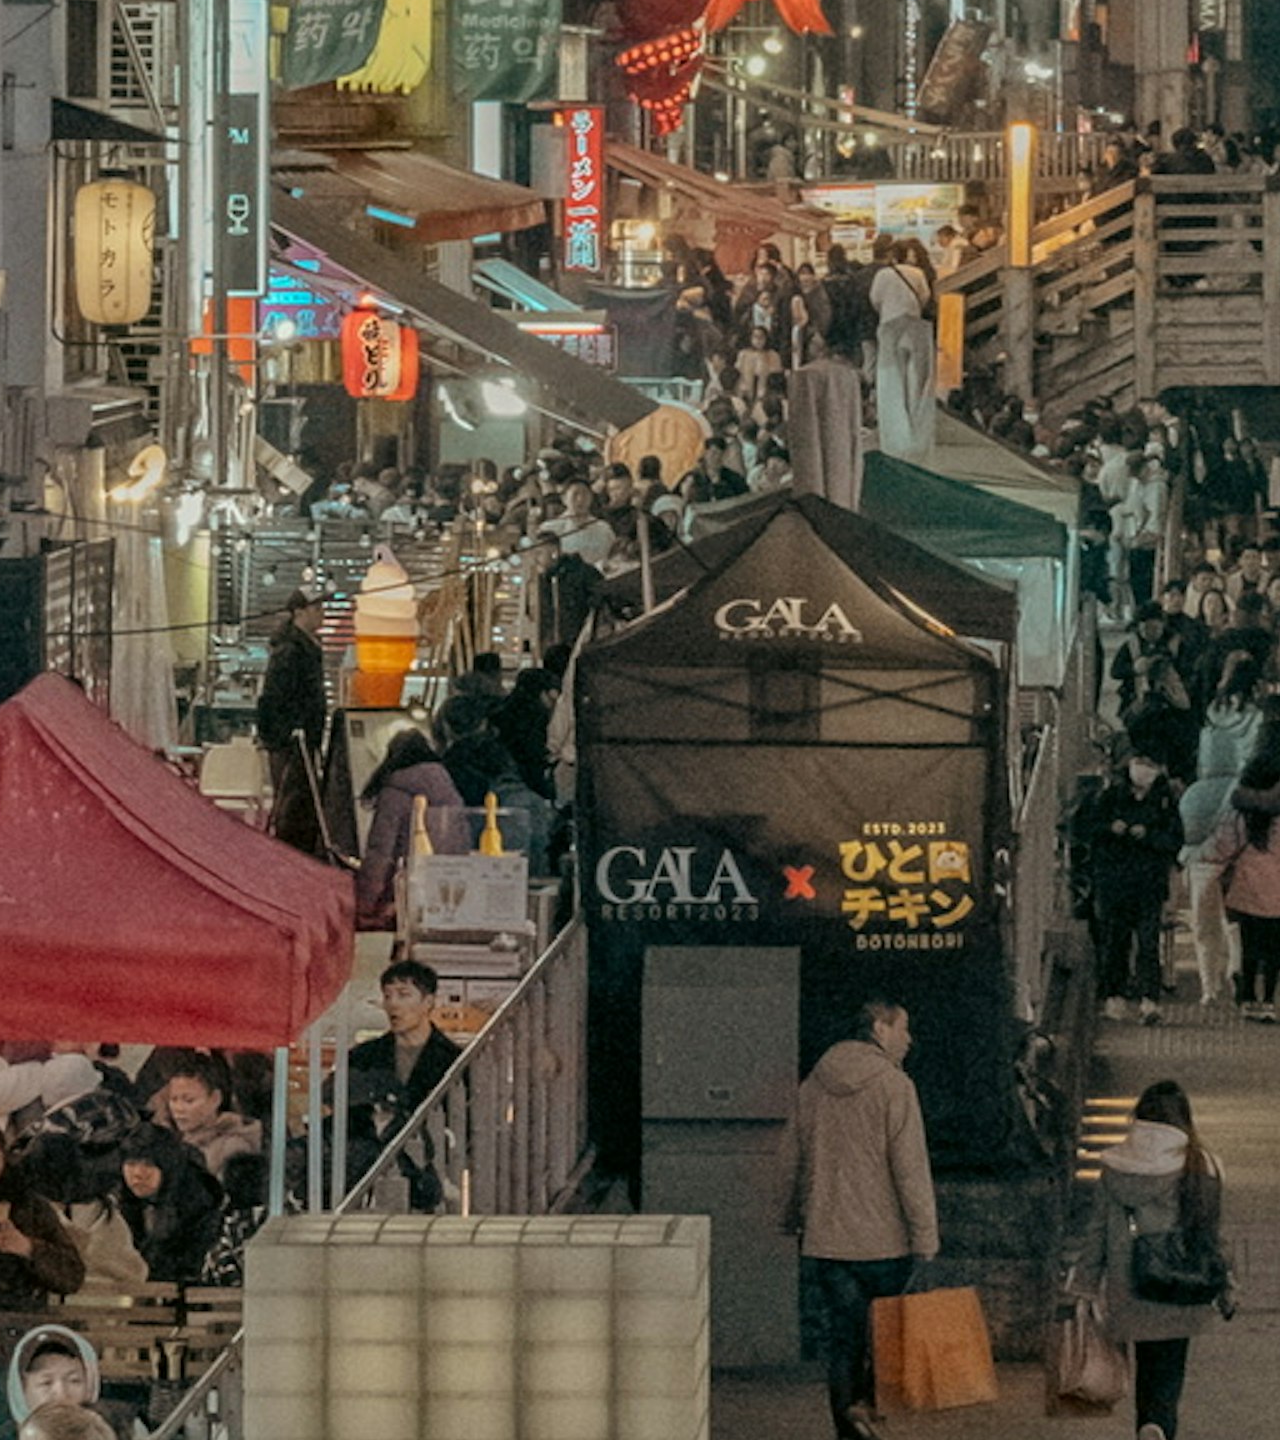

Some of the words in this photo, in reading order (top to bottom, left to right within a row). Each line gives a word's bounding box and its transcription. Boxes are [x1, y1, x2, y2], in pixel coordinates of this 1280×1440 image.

[463, 34, 501, 70] 药
[565, 109, 600, 271] ラーメン一蘭
[100, 192, 119, 298] モトカラ
[713, 596, 860, 635] GALA
[595, 846, 759, 905] GALA
[841, 887, 976, 930] チキン
